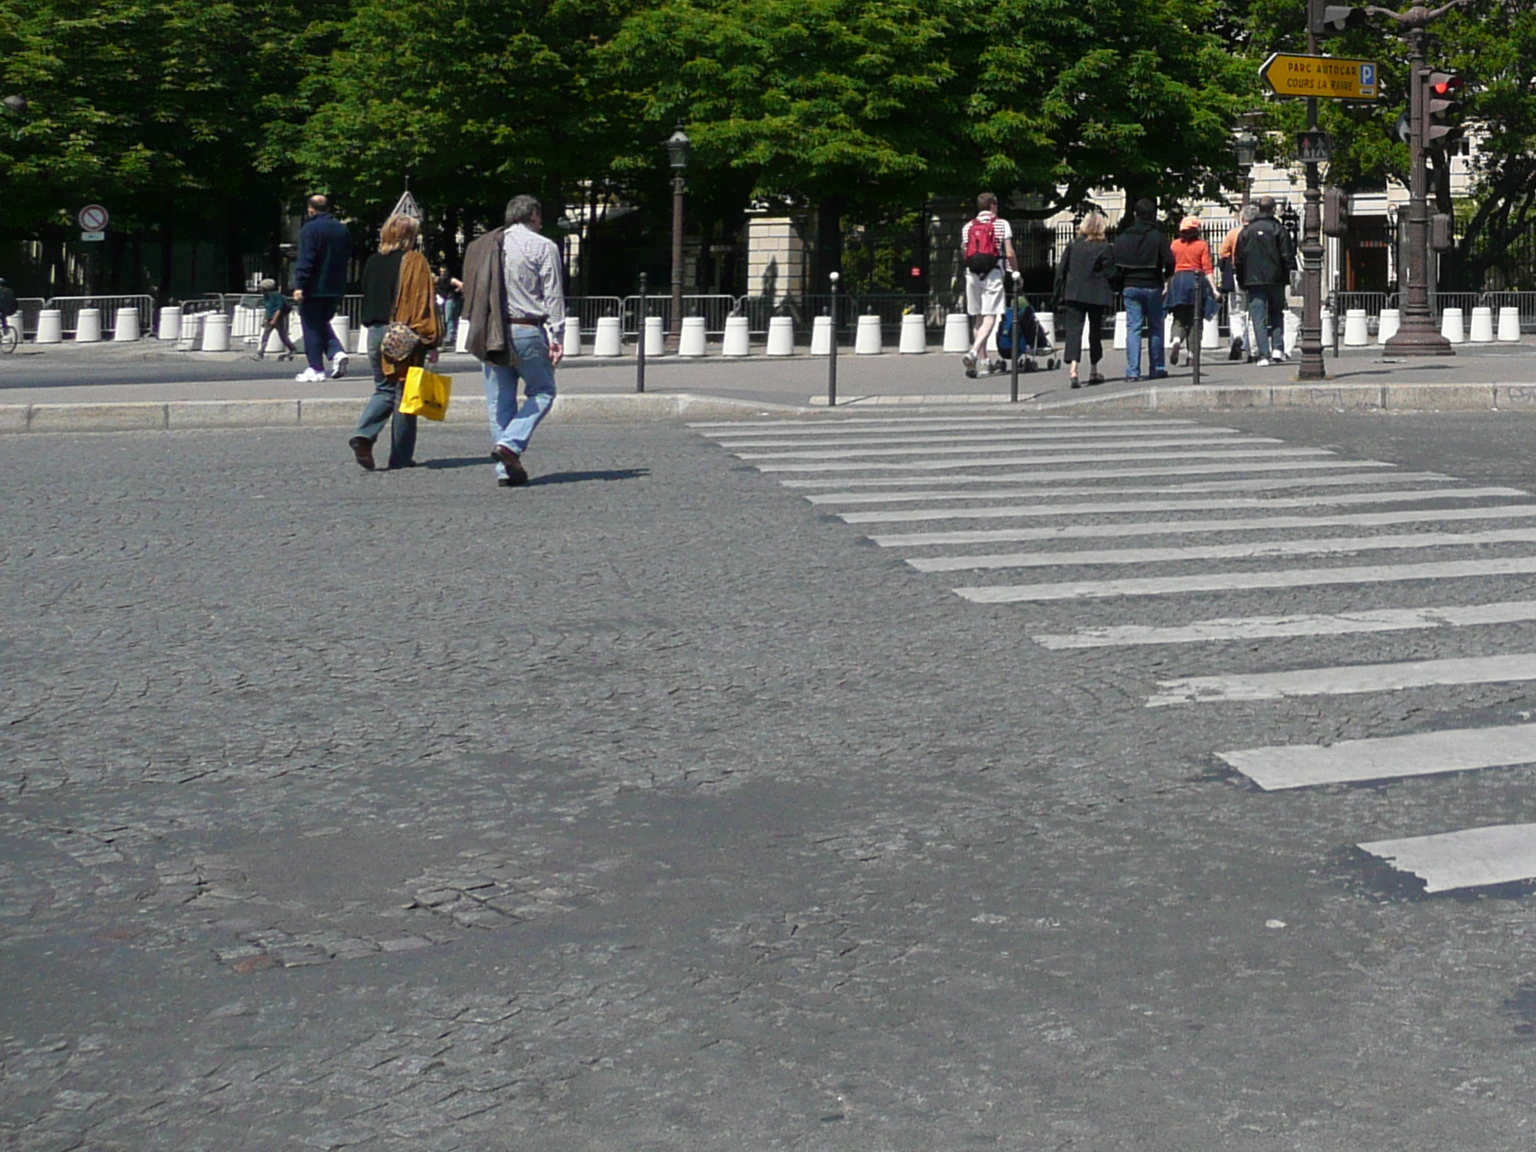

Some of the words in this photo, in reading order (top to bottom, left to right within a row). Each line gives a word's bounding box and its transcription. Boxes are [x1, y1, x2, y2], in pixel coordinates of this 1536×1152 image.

[1288, 62, 1311, 73] PARC
[1316, 64, 1357, 76] AUTOCAR
[1362, 66, 1372, 84] P
[1286, 78, 1315, 88] COURS
[1317, 79, 1327, 89] LA
[1330, 80, 1354, 91] REINE
